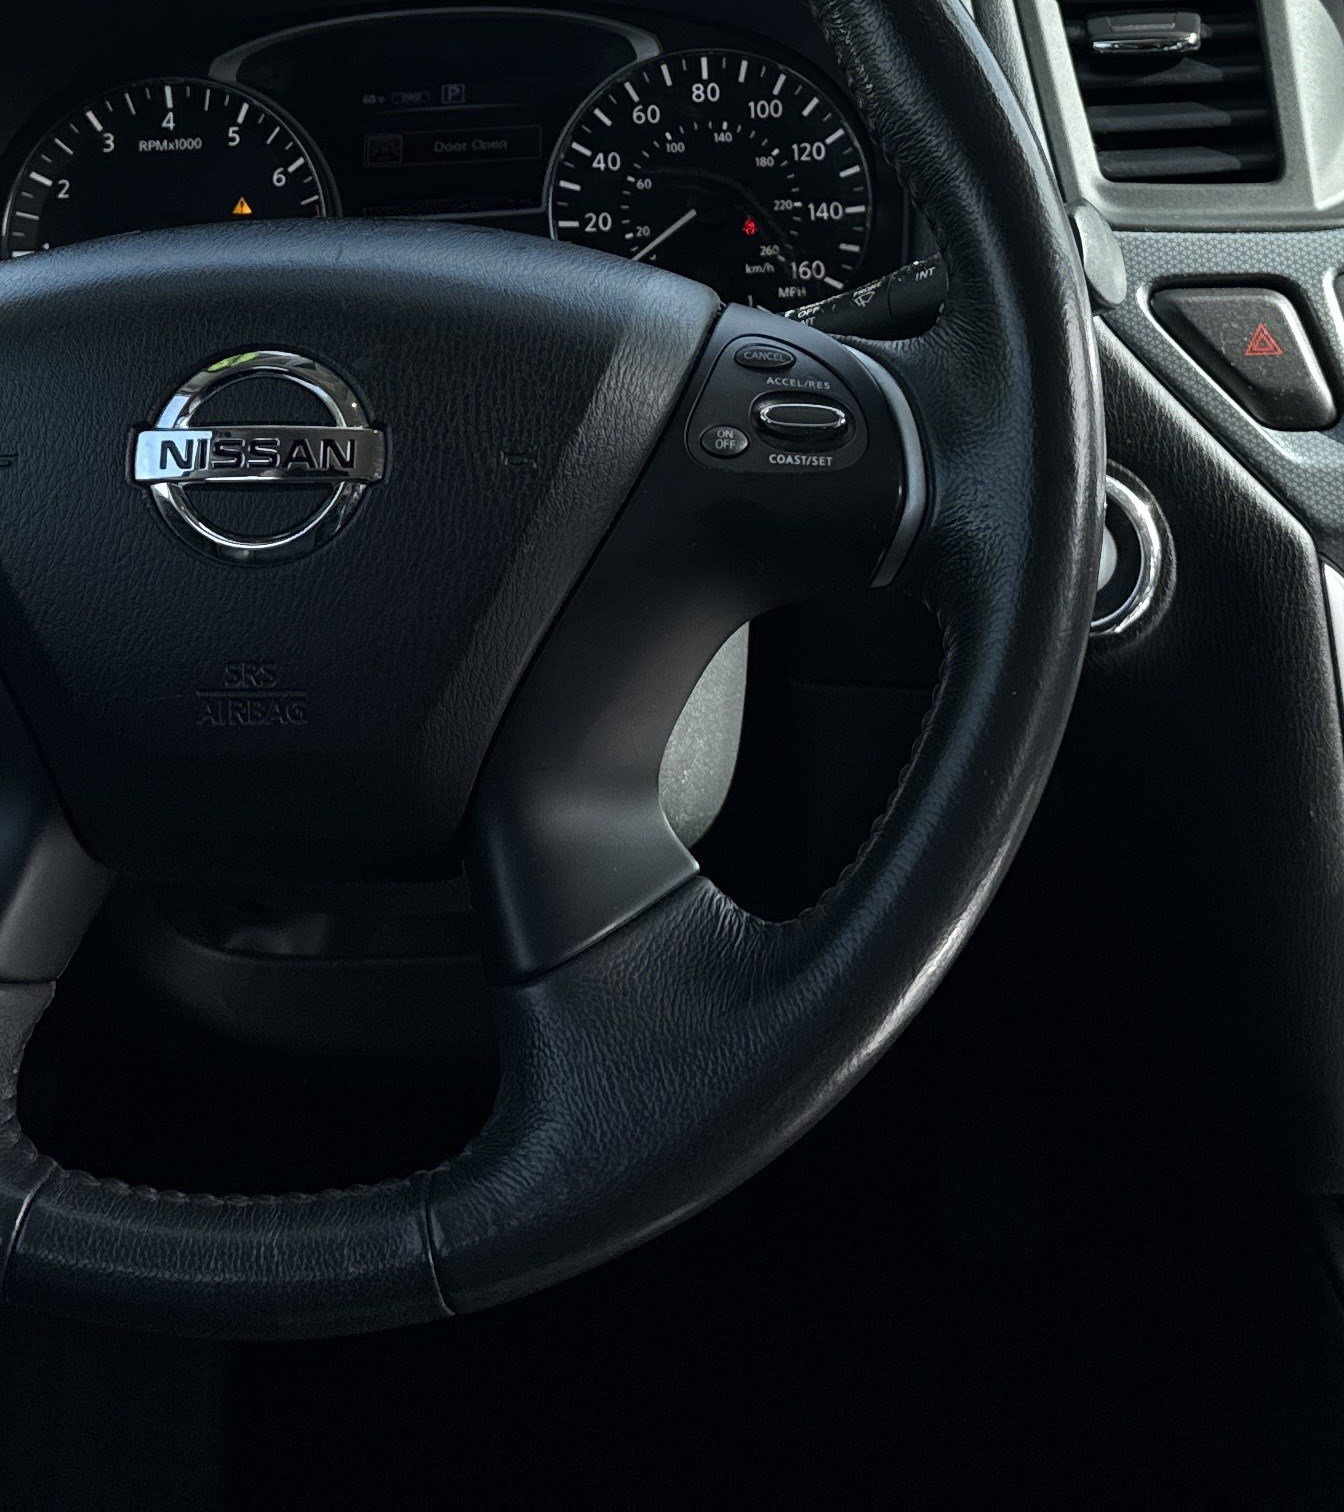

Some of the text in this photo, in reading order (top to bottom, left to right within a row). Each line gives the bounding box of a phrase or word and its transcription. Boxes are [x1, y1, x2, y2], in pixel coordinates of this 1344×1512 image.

[691, 81, 721, 104] 80
[631, 104, 662, 126] 60
[747, 99, 784, 120] 100
[161, 110, 176, 131] 4
[101, 132, 116, 153] 3
[138, 136, 203, 152] RPMx1000
[227, 126, 241, 147] 5
[713, 131, 734, 144] 140
[664, 141, 686, 154] 100
[791, 141, 827, 162] 120
[591, 151, 622, 171] 40
[754, 155, 775, 168] 180
[271, 167, 287, 187] 6
[635, 178, 653, 191] 60
[56, 178, 71, 200] 2
[772, 199, 794, 211] 220
[807, 201, 844, 222] 140
[583, 212, 613, 233] 20
[634, 225, 651, 238] 20
[759, 244, 780, 257] 260
[744, 261, 776, 275] km/h
[791, 259, 826, 281] 160
[914, 266, 937, 282] INT
[777, 286, 807, 299] MPH
[797, 306, 821, 319] OFF
[743, 349, 787, 364] CANCEL
[765, 375, 832, 391] ACCEL/RES
[715, 428, 734, 439] ON
[714, 439, 737, 450] OFF
[158, 436, 357, 472] NISSAN
[768, 452, 834, 468] COAST/SET
[224, 658, 279, 688] SRS
[196, 698, 309, 727] AIRBAG
